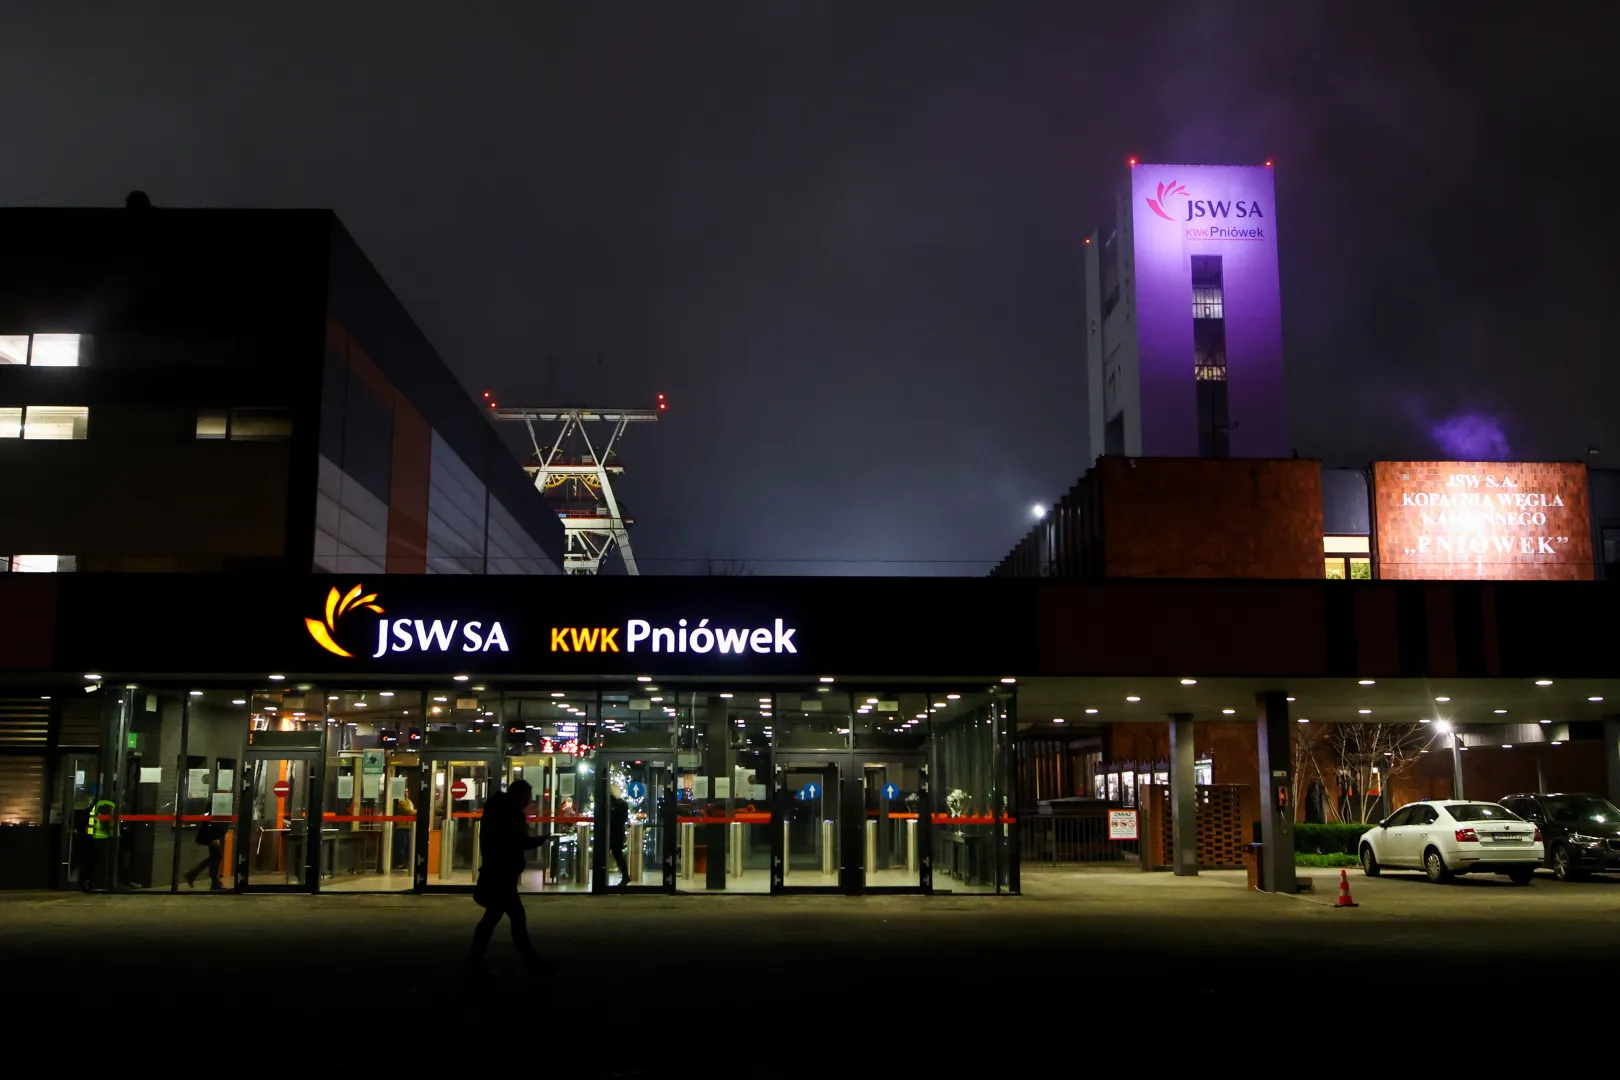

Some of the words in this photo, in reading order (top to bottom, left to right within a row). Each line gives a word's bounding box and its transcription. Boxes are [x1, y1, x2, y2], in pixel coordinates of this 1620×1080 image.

[1186, 200, 1231, 221] JSW
[1236, 201, 1263, 217] SA
[1186, 229, 1208, 237] KWK
[1210, 226, 1264, 238] Pniówek
[1447, 474, 1481, 487] JSW
[1403, 492, 1494, 507] KOPALNIA
[1497, 493, 1564, 510] WĘGLA
[1422, 511, 1546, 525] KANNEGO
[372, 618, 459, 658] JSW
[462, 621, 510, 652] SA
[550, 627, 620, 653] KWK
[626, 617, 799, 655] Pniówek
